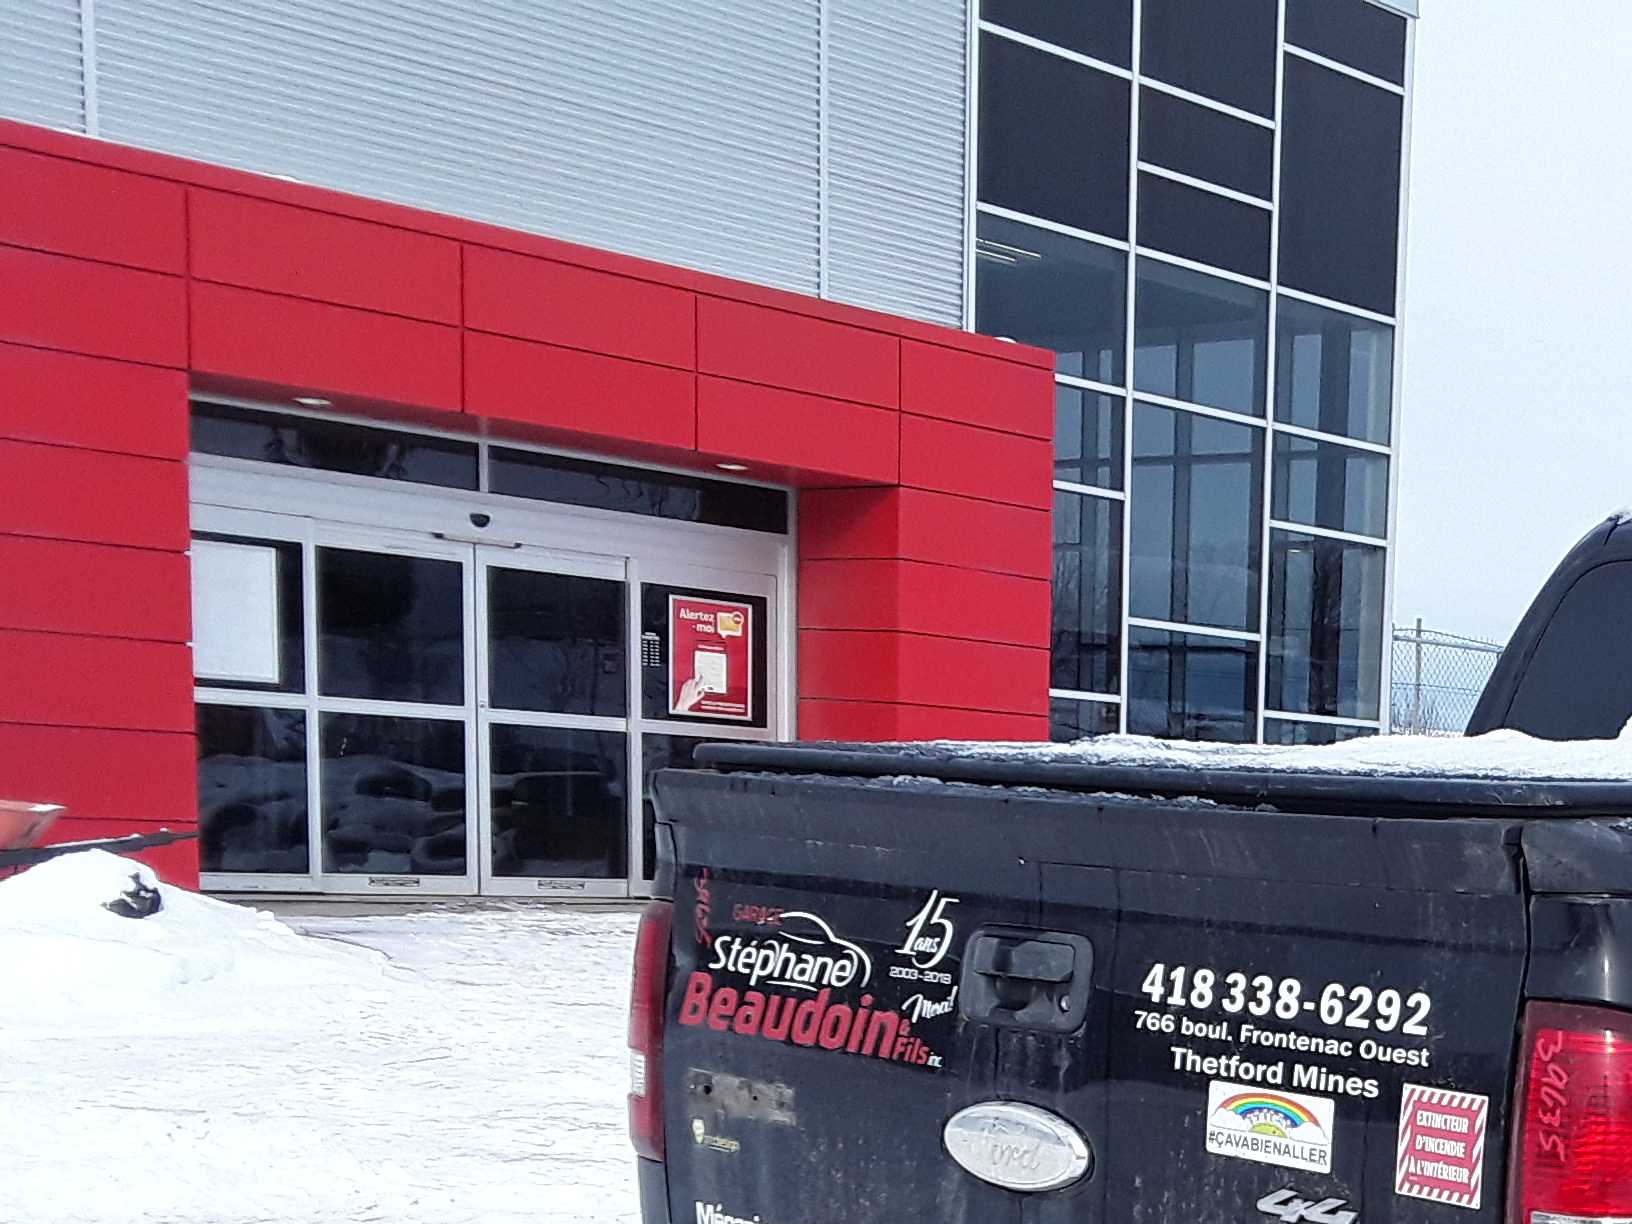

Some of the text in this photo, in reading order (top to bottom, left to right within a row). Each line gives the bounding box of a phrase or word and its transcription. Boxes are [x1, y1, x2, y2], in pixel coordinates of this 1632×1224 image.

[680, 608, 715, 623] Alertez
[895, 889, 960, 969] 15
[709, 936, 859, 987] Stéphane
[679, 972, 901, 1060] Beaudoin
[893, 1036, 929, 1065] Fils
[1141, 962, 1431, 1037] 418 338-6292
[1134, 1010, 1430, 1068] 766 boul. Frontenac Ouest
[1171, 1046, 1380, 1099] Thetford Mines
[1537, 1031, 1569, 1161] 39635
[1415, 1134, 1466, 1159] D'INCENDIE
[1416, 1110, 1469, 1133] EXTINCTEUR
[1416, 1160, 1469, 1184] L'INTÉRIEUR
